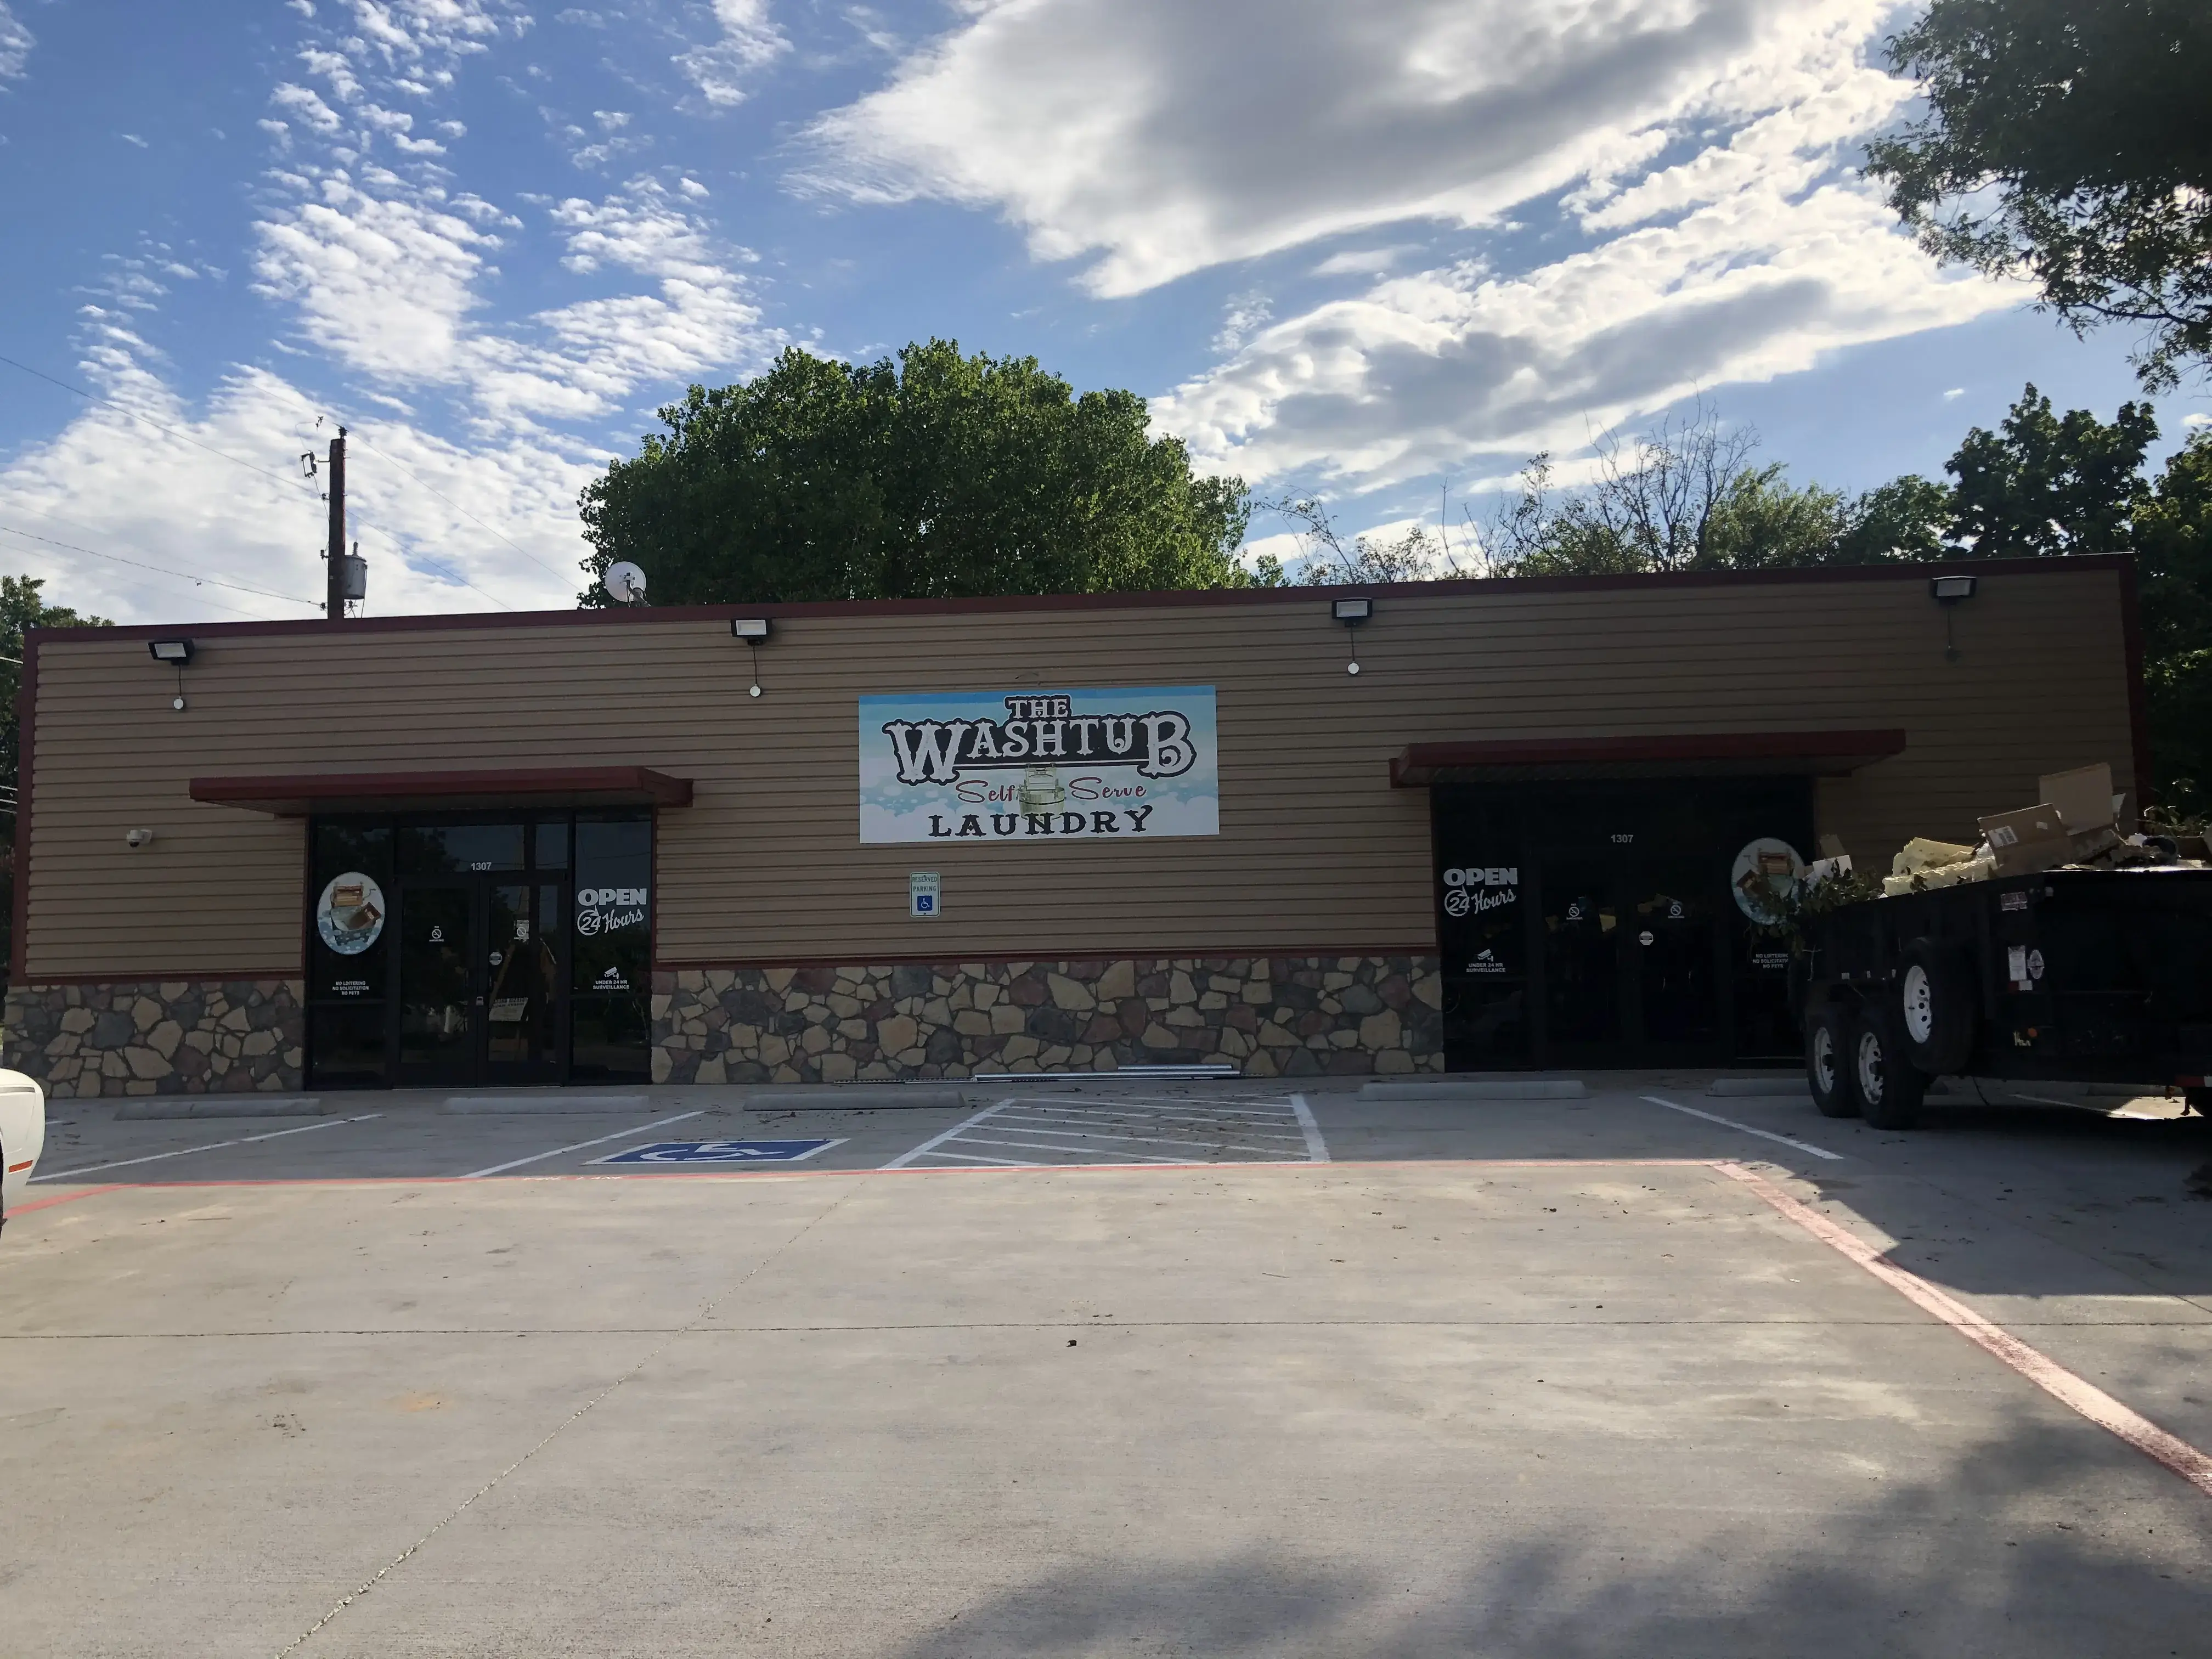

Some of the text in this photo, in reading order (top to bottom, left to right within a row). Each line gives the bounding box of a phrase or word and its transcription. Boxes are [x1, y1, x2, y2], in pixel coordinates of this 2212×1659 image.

[1006, 697, 1070, 720] THE
[884, 712, 1195, 785] WASHTUB
[956, 776, 1147, 803] Self Serve
[928, 804, 1153, 837] LAUNDRY
[1611, 834, 1634, 843] 1307
[471, 862, 492, 871] 1307
[1443, 867, 1518, 886] OPEN
[578, 888, 647, 906] OPEN
[1448, 889, 1516, 915] 24 Hours
[580, 909, 645, 933] 24 Hours
